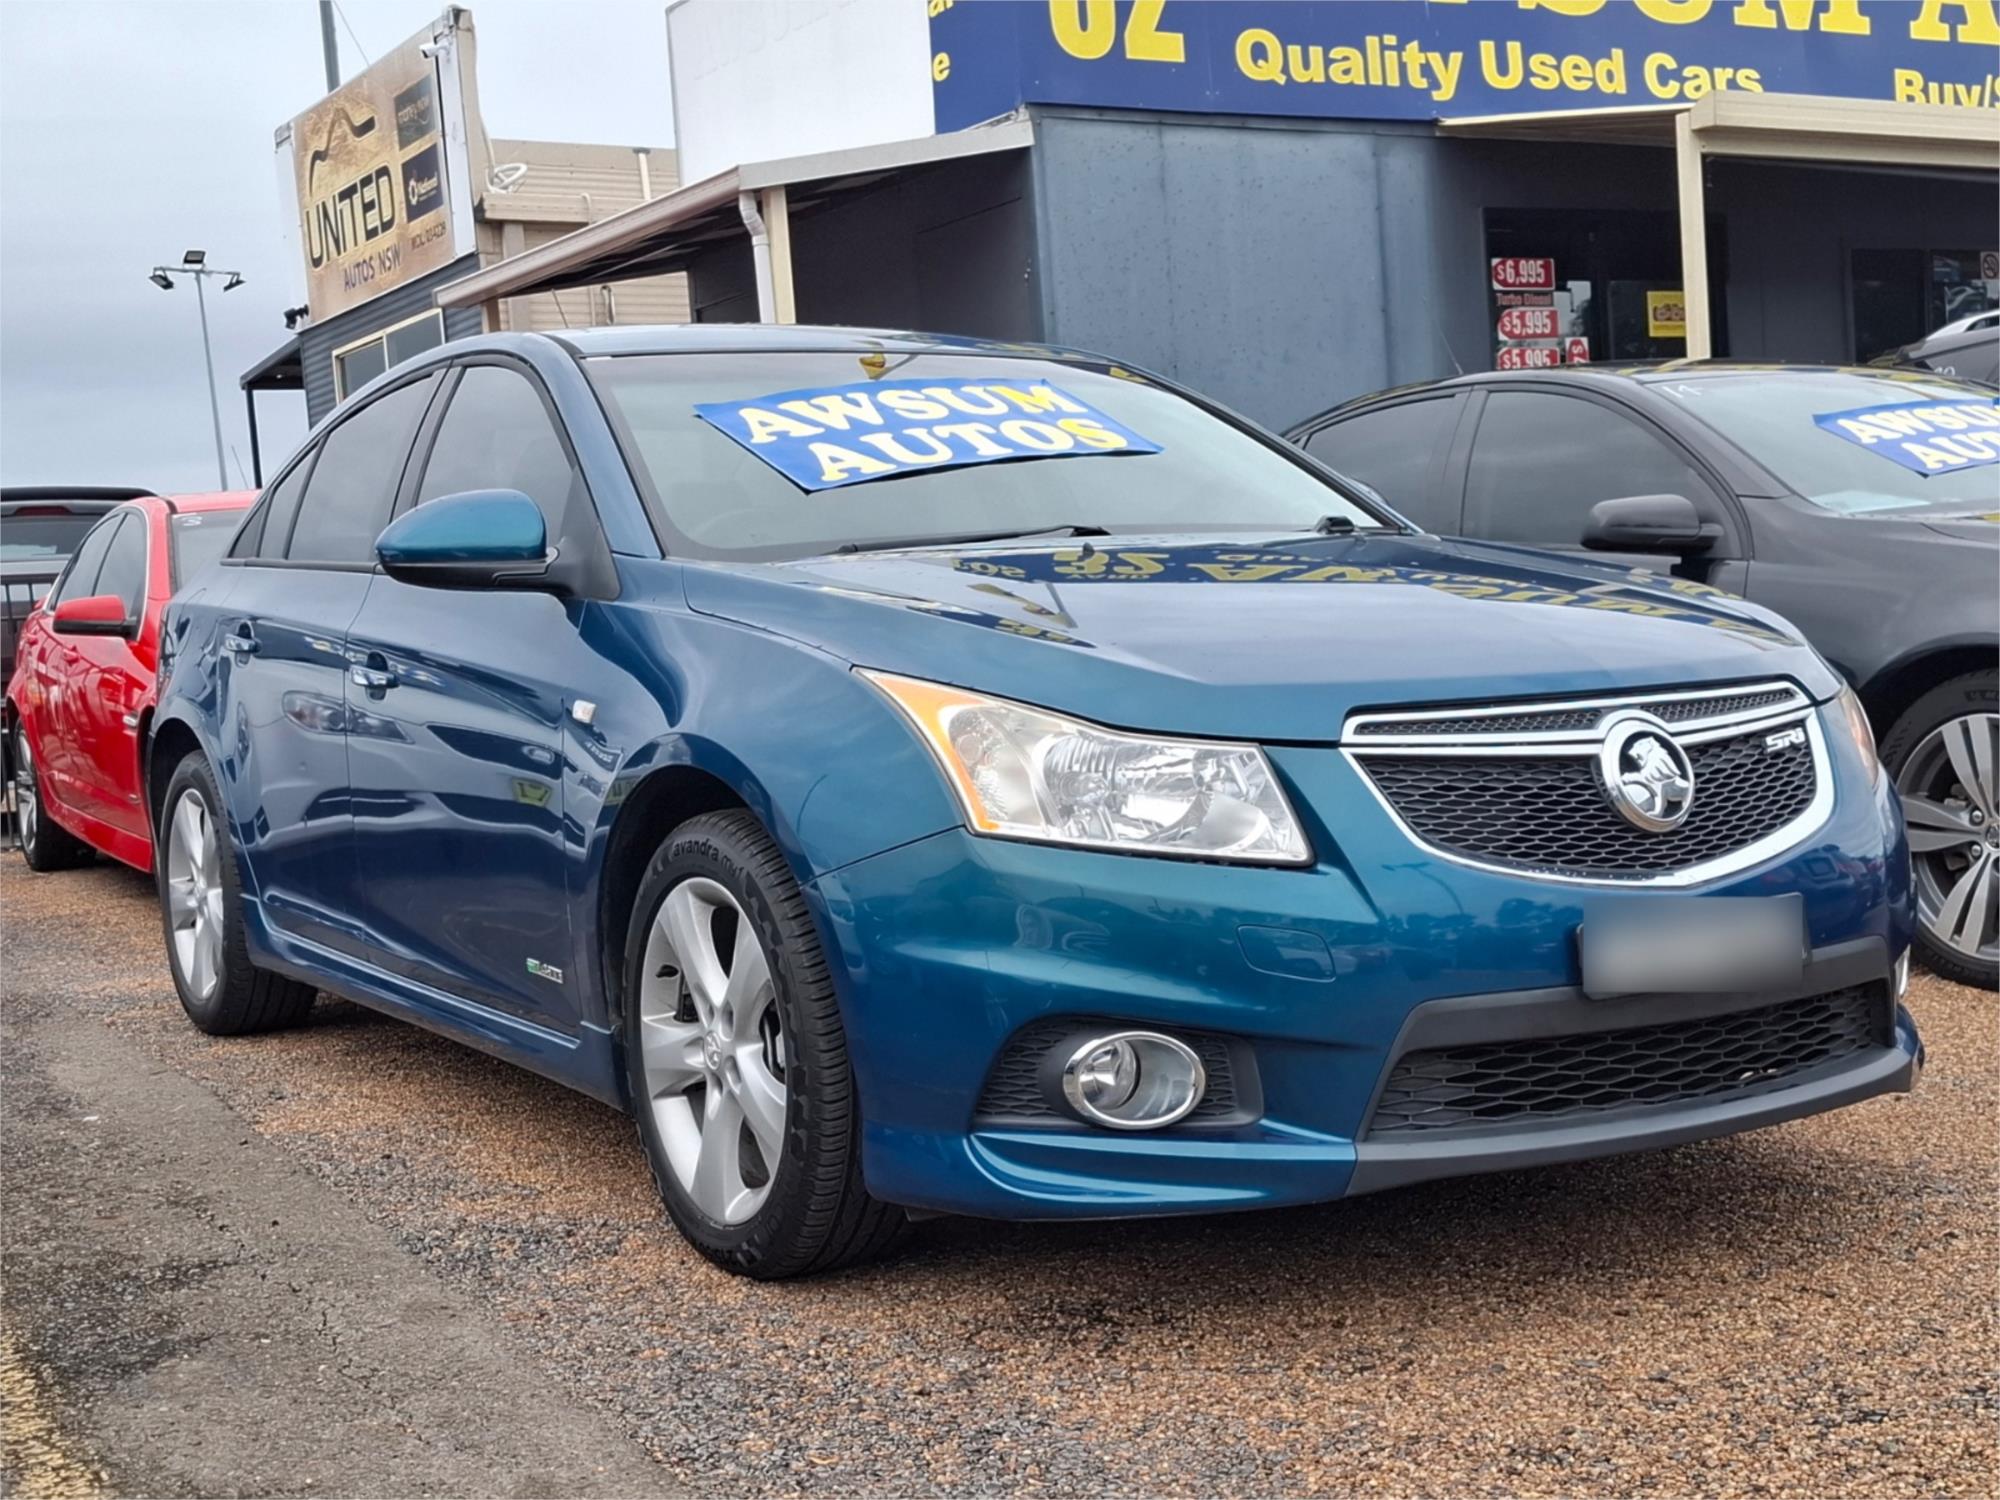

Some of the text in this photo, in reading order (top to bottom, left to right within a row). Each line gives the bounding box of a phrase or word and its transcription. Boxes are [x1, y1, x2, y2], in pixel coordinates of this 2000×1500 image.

[1235, 28, 1764, 101] Quality Used Cars
[1894, 68, 2000, 108] Buy/
[344, 243, 401, 292] AUTOS NSW
[1497, 260, 1545, 284] $6,995
[1503, 311, 1551, 335] $5,995
[737, 384, 1089, 445] AWSUM
[1837, 405, 2000, 444] AWSU
[807, 418, 1129, 482] AUTOS
